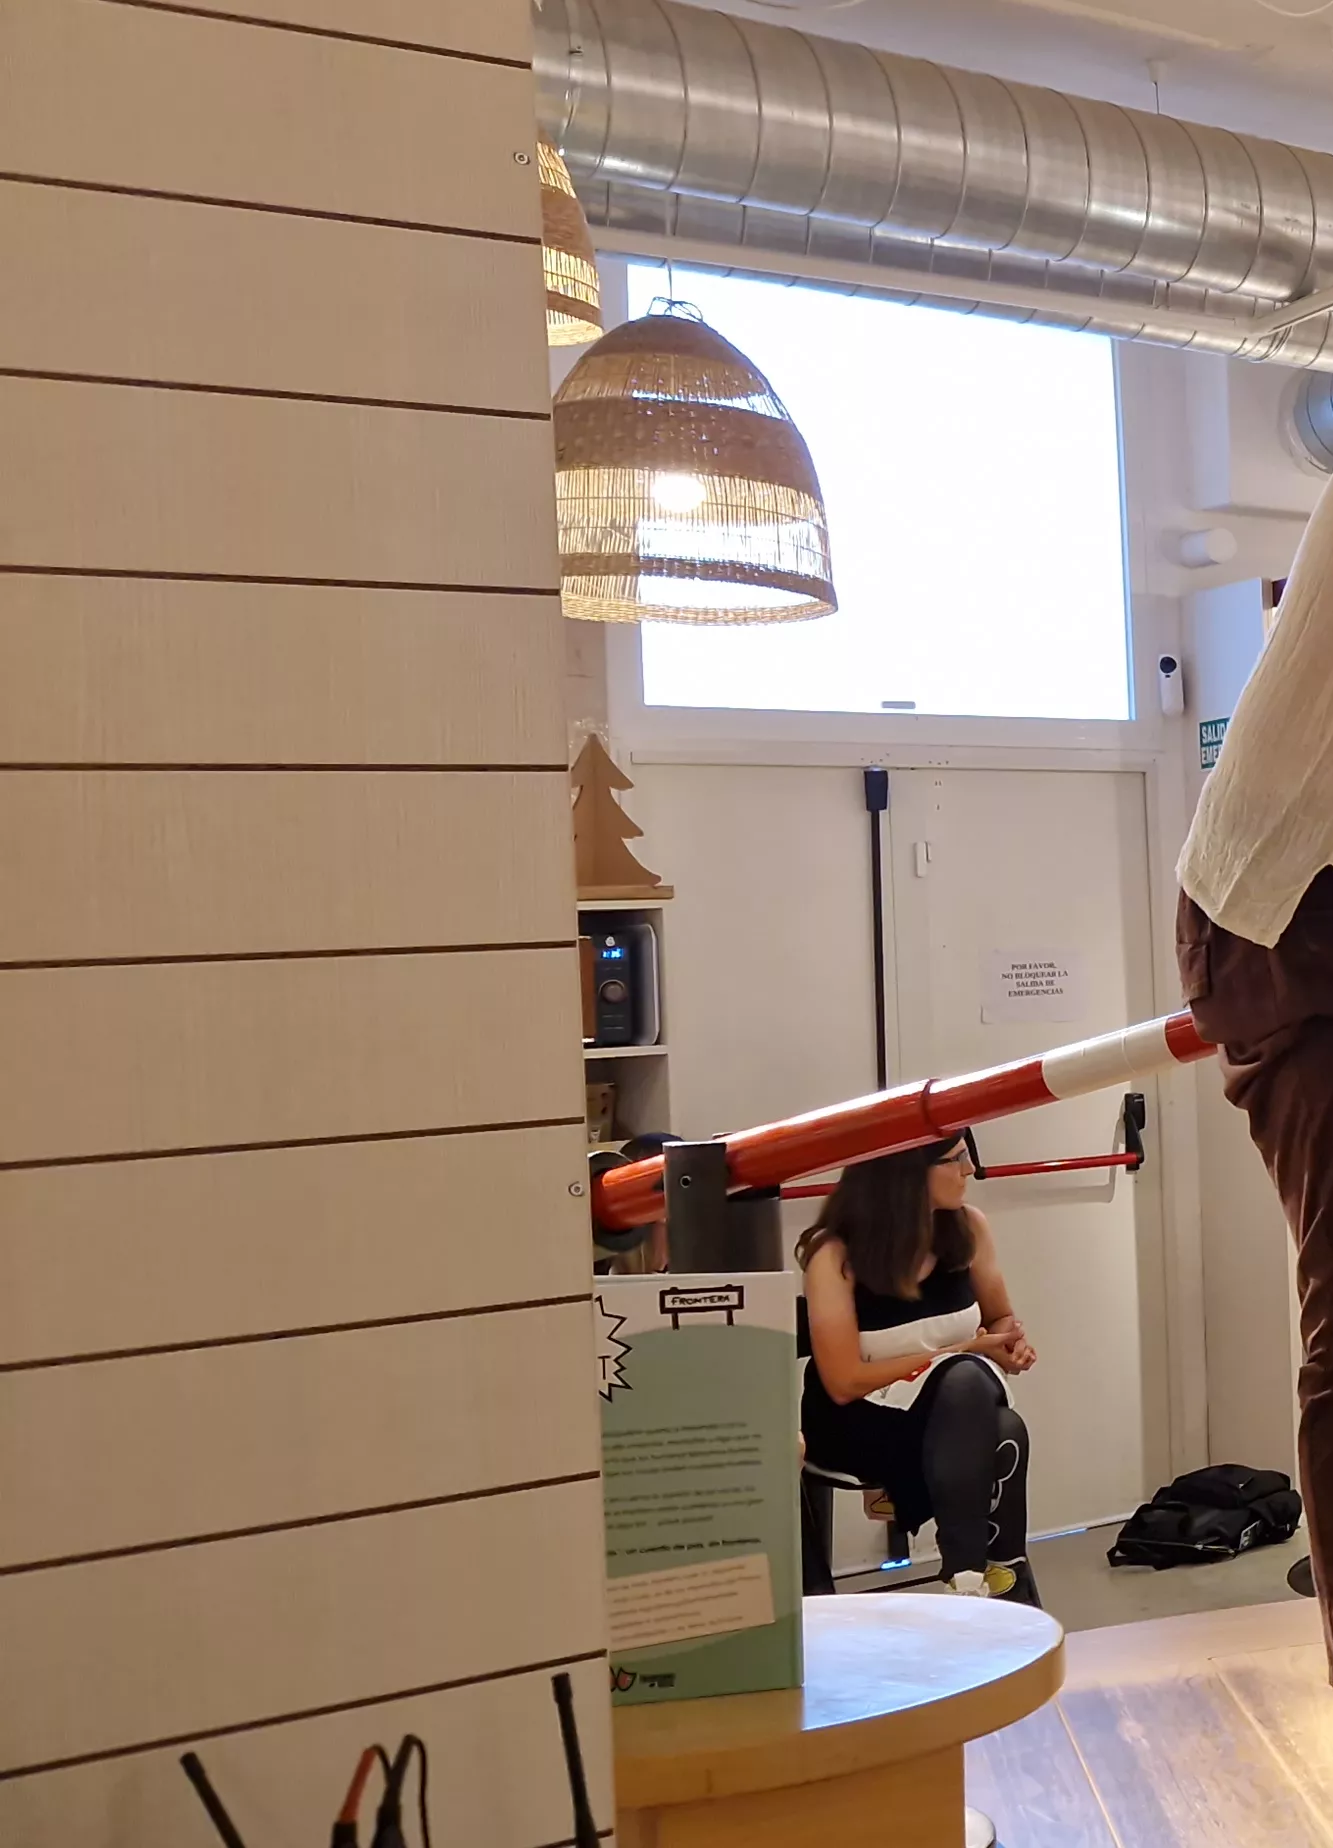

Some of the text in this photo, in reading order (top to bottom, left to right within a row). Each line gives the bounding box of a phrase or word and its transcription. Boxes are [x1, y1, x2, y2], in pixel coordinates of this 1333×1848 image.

[1202, 723, 1227, 743] SALID
[1015, 971, 1057, 980] BLOQUEAR
[1058, 970, 1069, 978] LA
[1045, 979, 1055, 987] DE
[1008, 987, 1064, 998] EMERGENCIAS
[671, 1295, 731, 1306] FRONTERA
